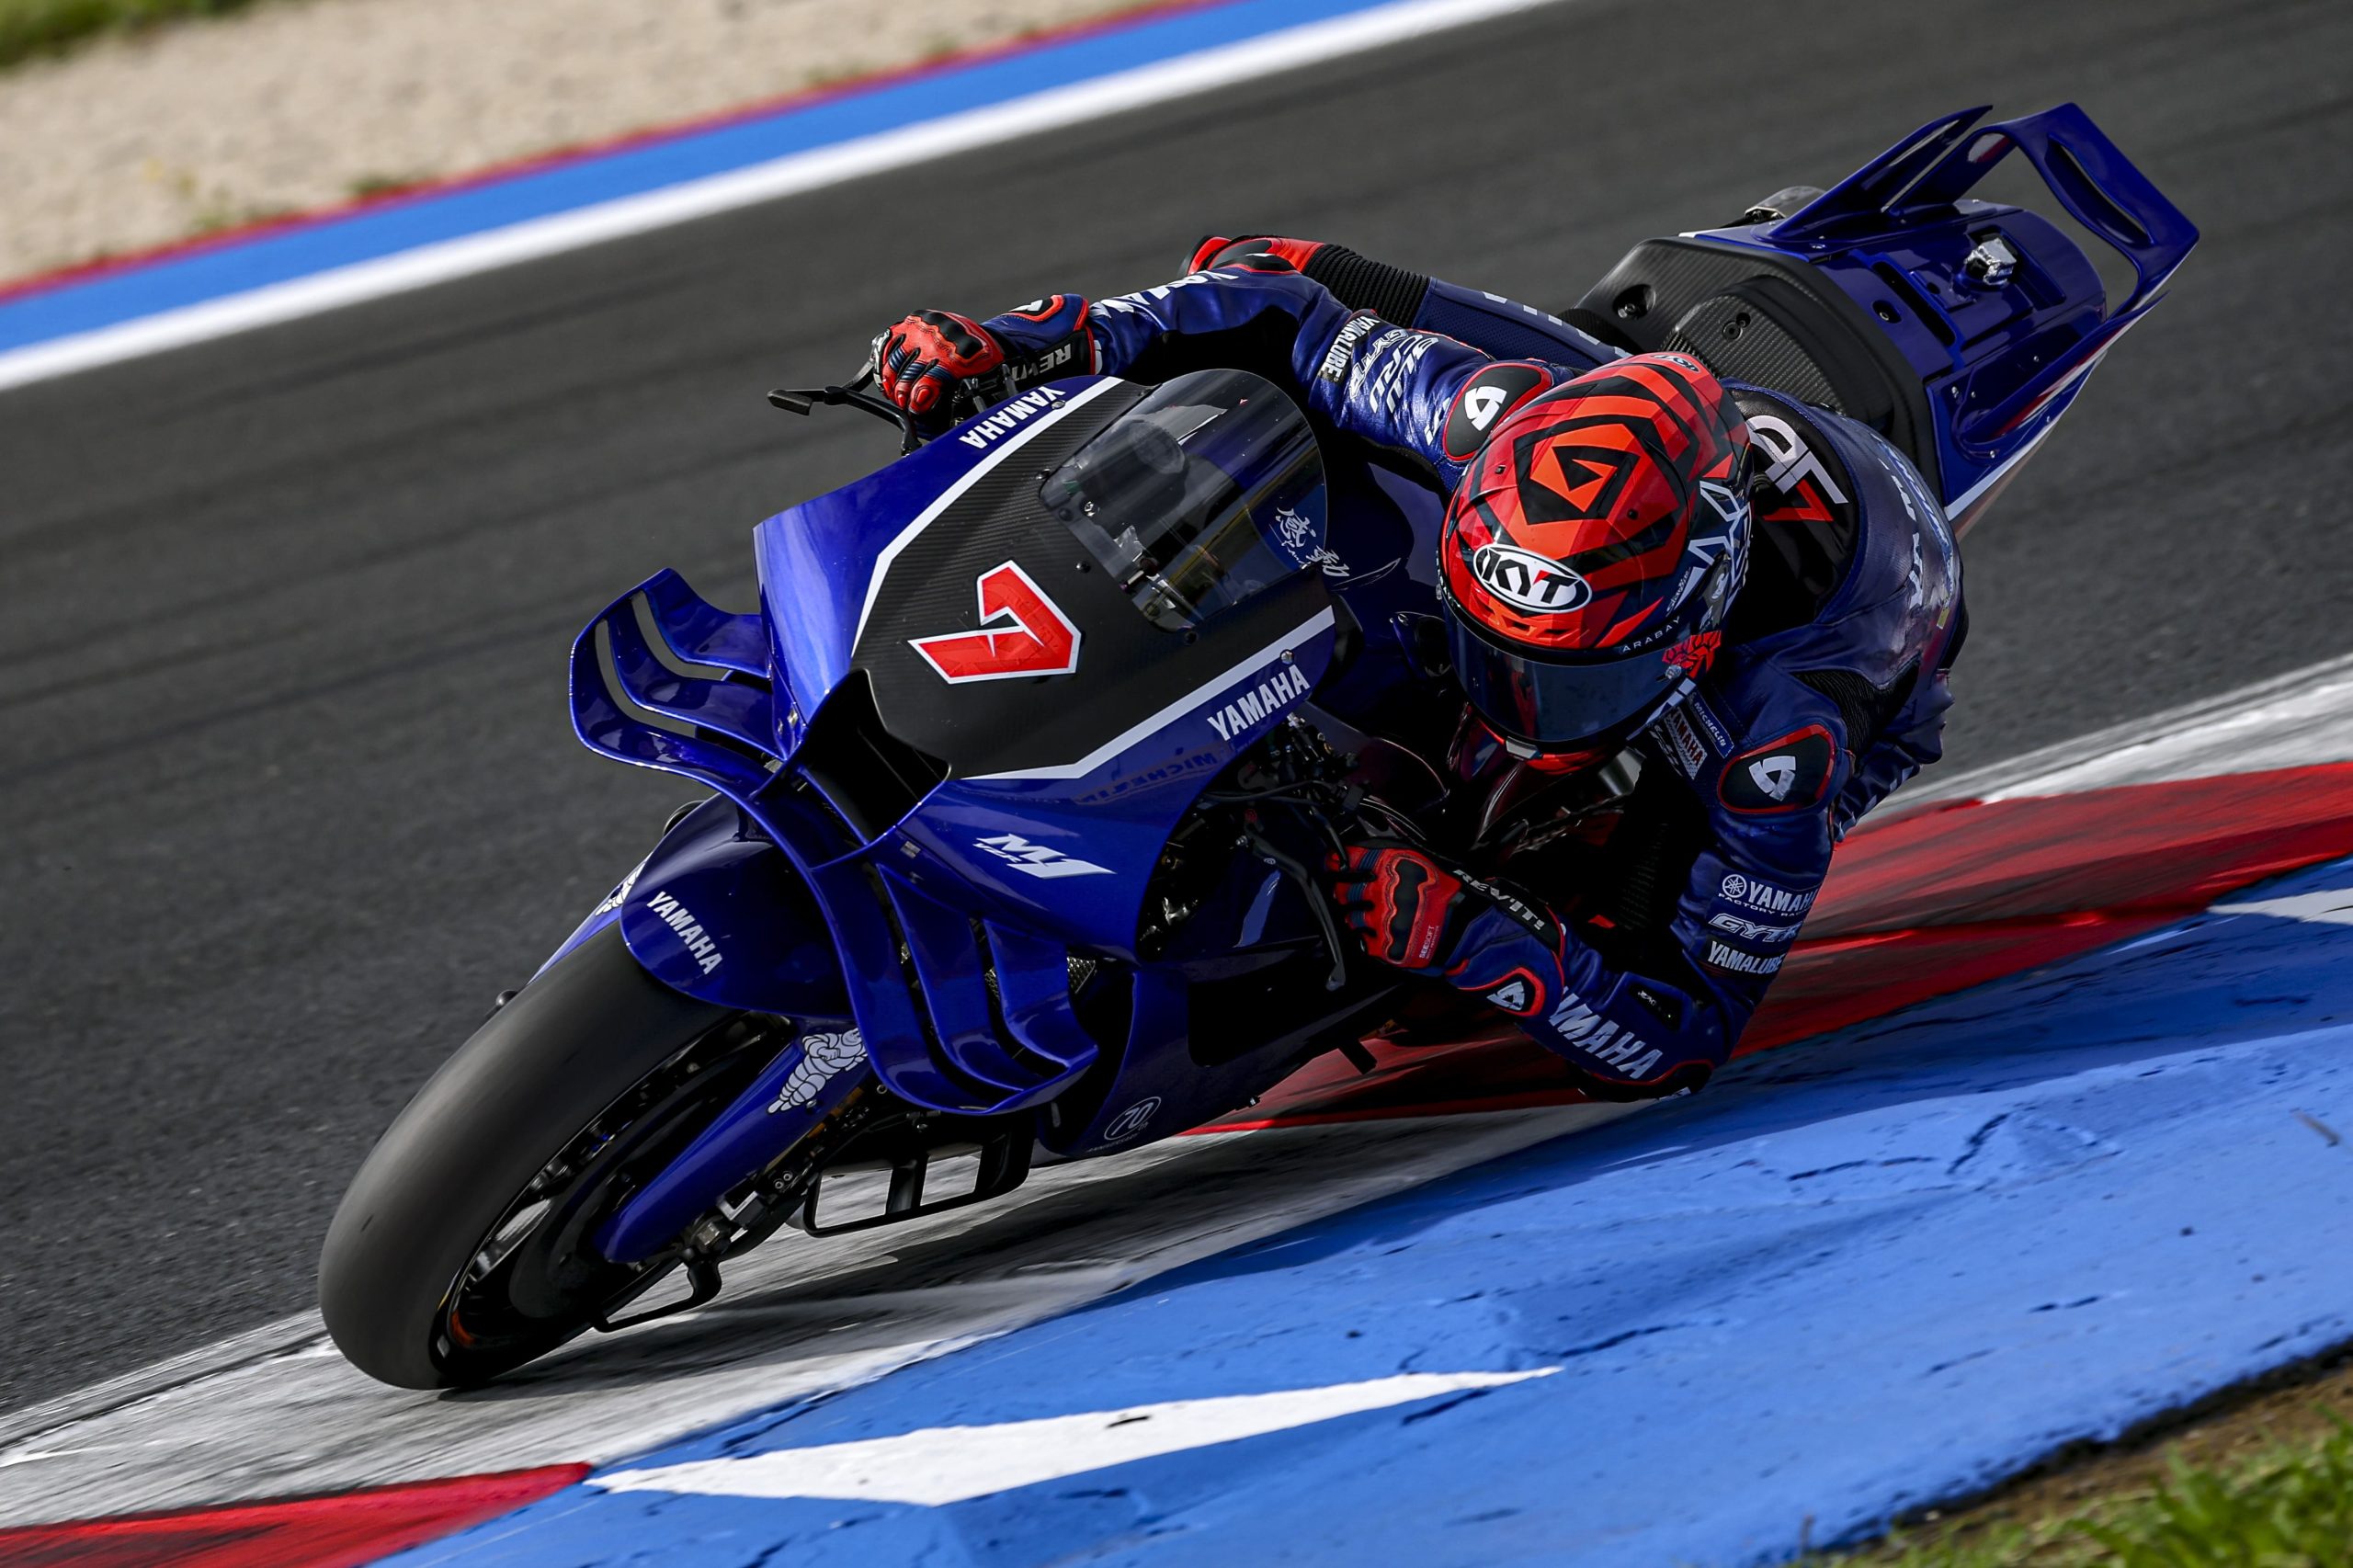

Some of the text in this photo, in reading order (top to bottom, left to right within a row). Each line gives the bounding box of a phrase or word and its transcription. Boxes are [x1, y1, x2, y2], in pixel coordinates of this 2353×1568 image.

[959, 385, 1066, 449] YAMAHA
[1480, 551, 1582, 606] KYT
[1207, 664, 1311, 741] YAMAHA
[1694, 701, 1727, 747] MICHELIN
[646, 891, 723, 975] YAMAHA
[1718, 892, 1776, 915] FACTORY
